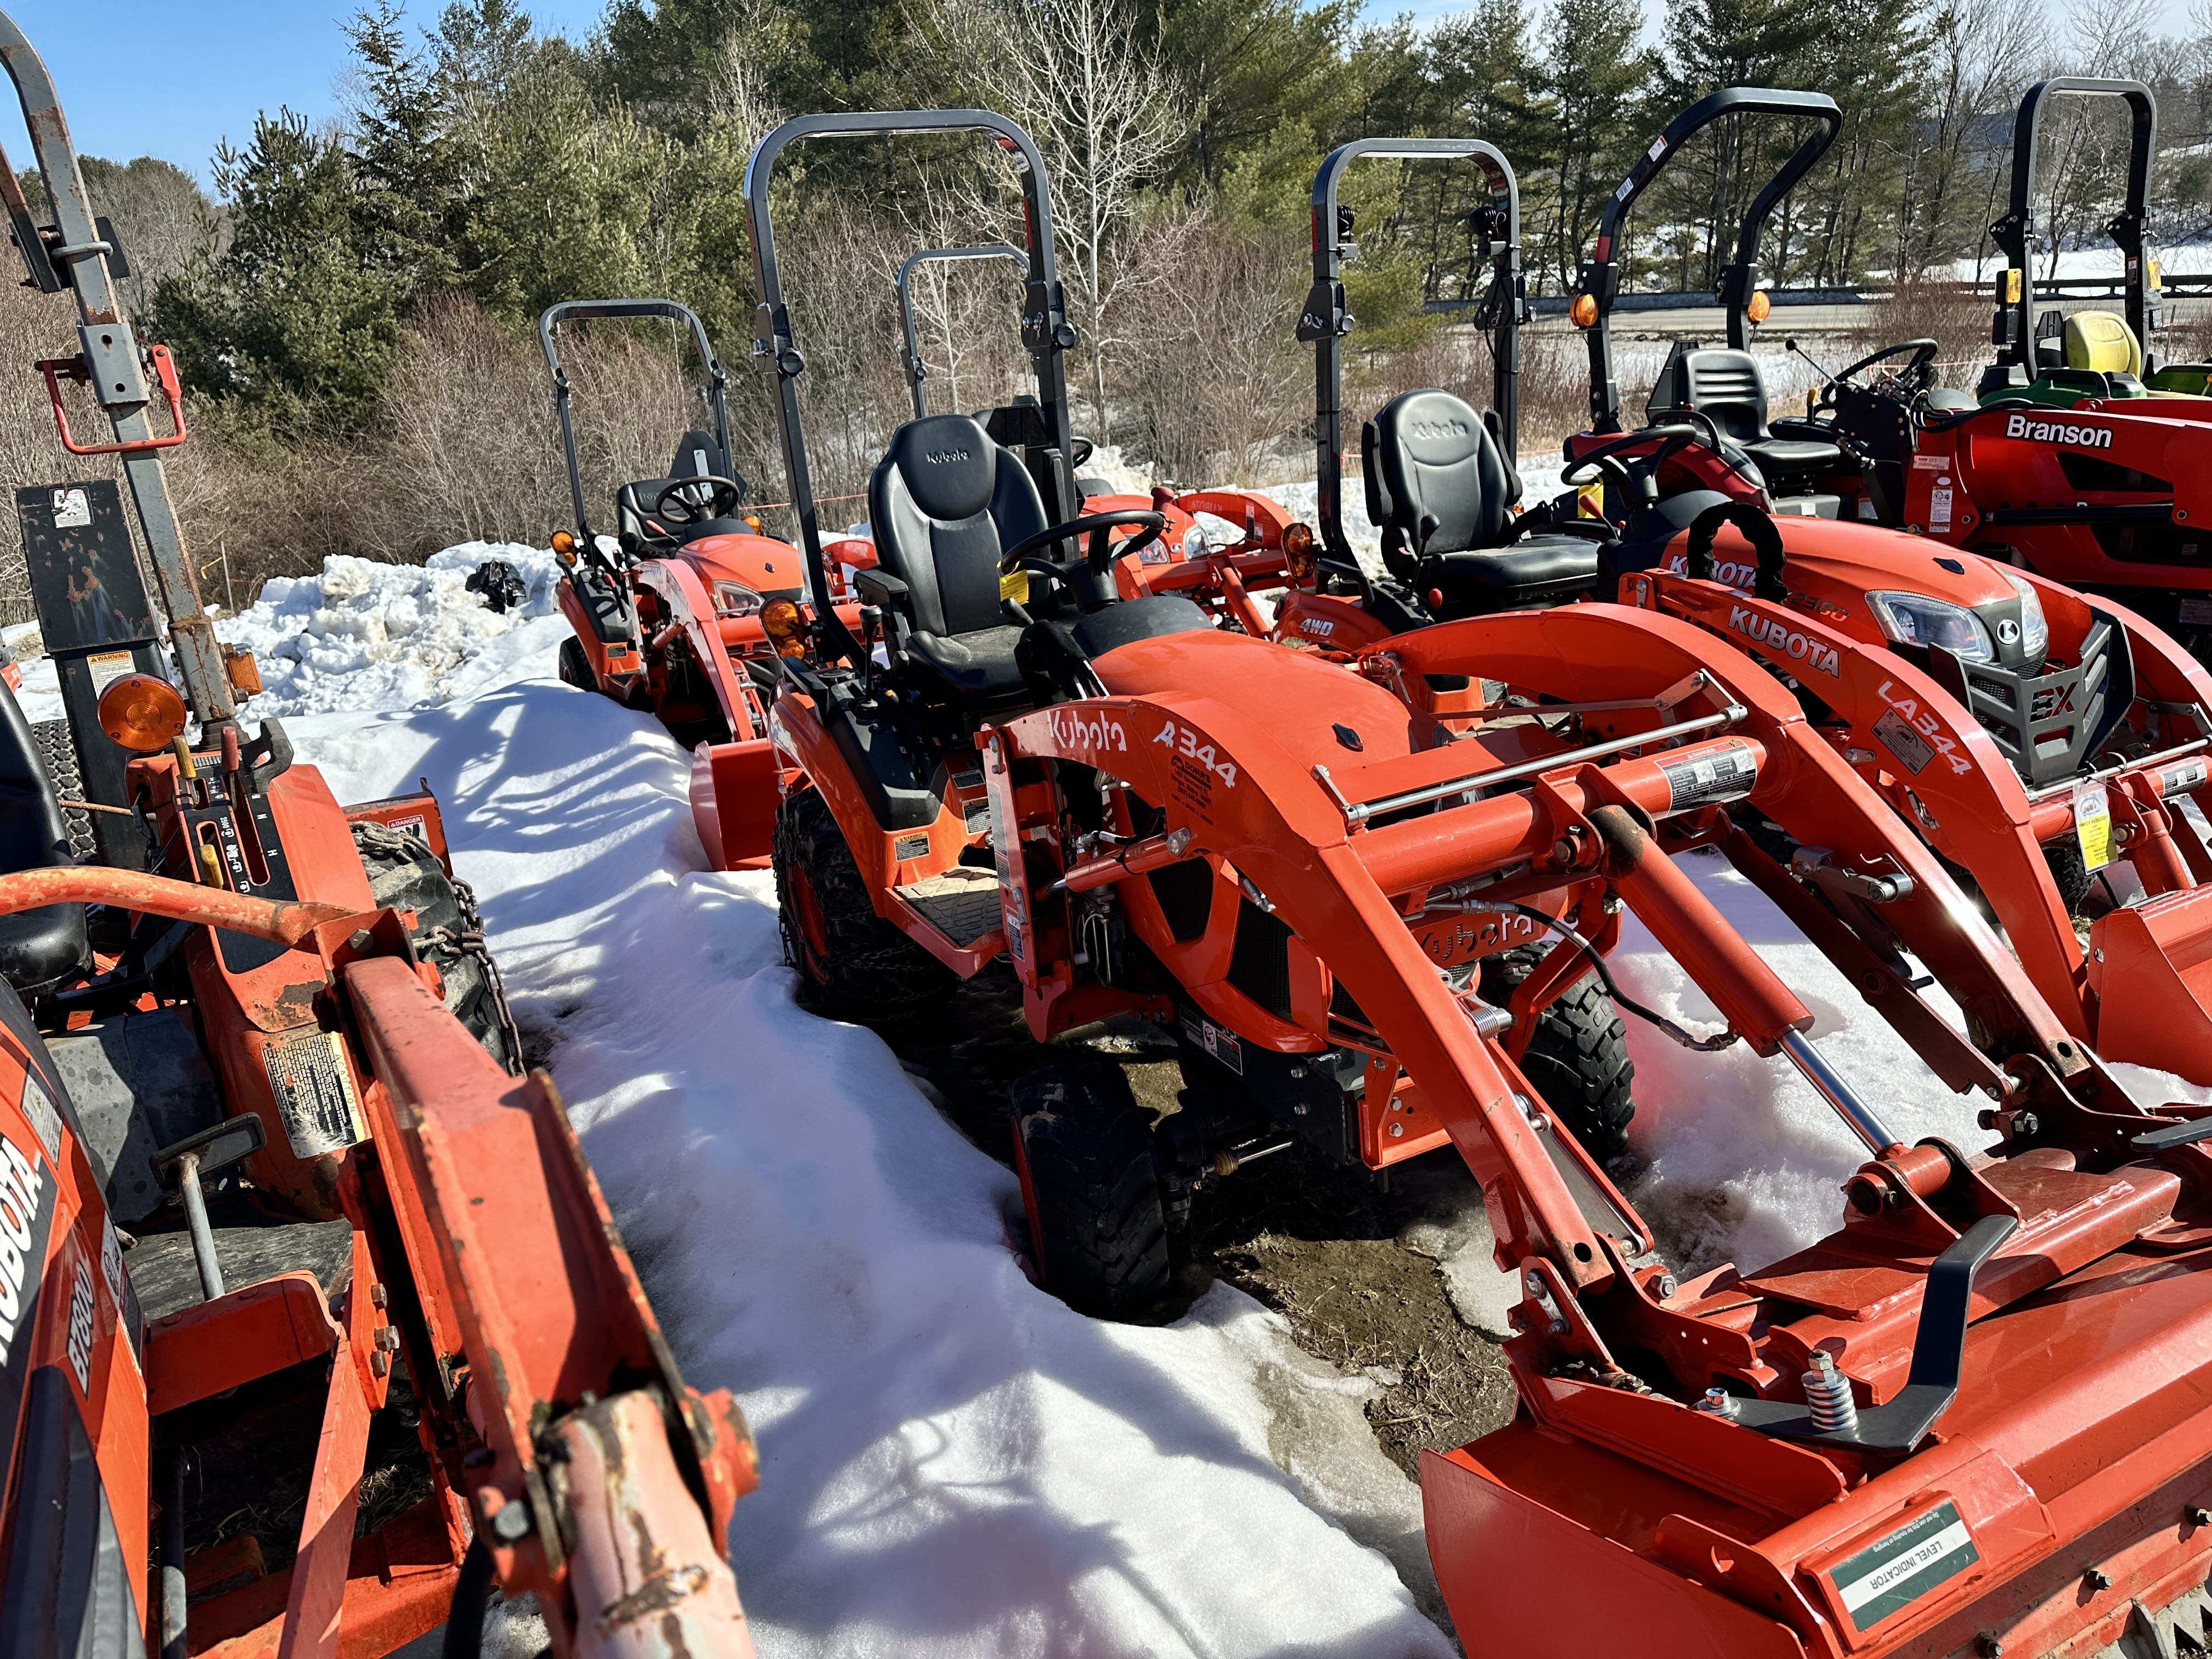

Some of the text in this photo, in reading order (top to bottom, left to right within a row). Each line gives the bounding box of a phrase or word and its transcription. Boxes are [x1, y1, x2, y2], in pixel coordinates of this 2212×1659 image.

[1412, 420, 1468, 440] Kubota
[2007, 415, 2112, 448] Branson
[927, 448, 970, 464] Kubota
[1299, 618, 1334, 636] 4WD
[1728, 605, 1840, 678] KUBOTA
[97, 652, 128, 662] WARNING
[2030, 681, 2078, 723] BX
[1046, 710, 1127, 752] Kubota
[1878, 680, 1972, 775] LA344
[1691, 748, 1717, 758] DANGER
[220, 816, 230, 829] 2500
[395, 816, 421, 826] DANGER
[338, 1060, 357, 1112] CAUTION
[69, 1263, 94, 1395] B7800
[1870, 1541, 1943, 1590] LEVEL INDICATOR
